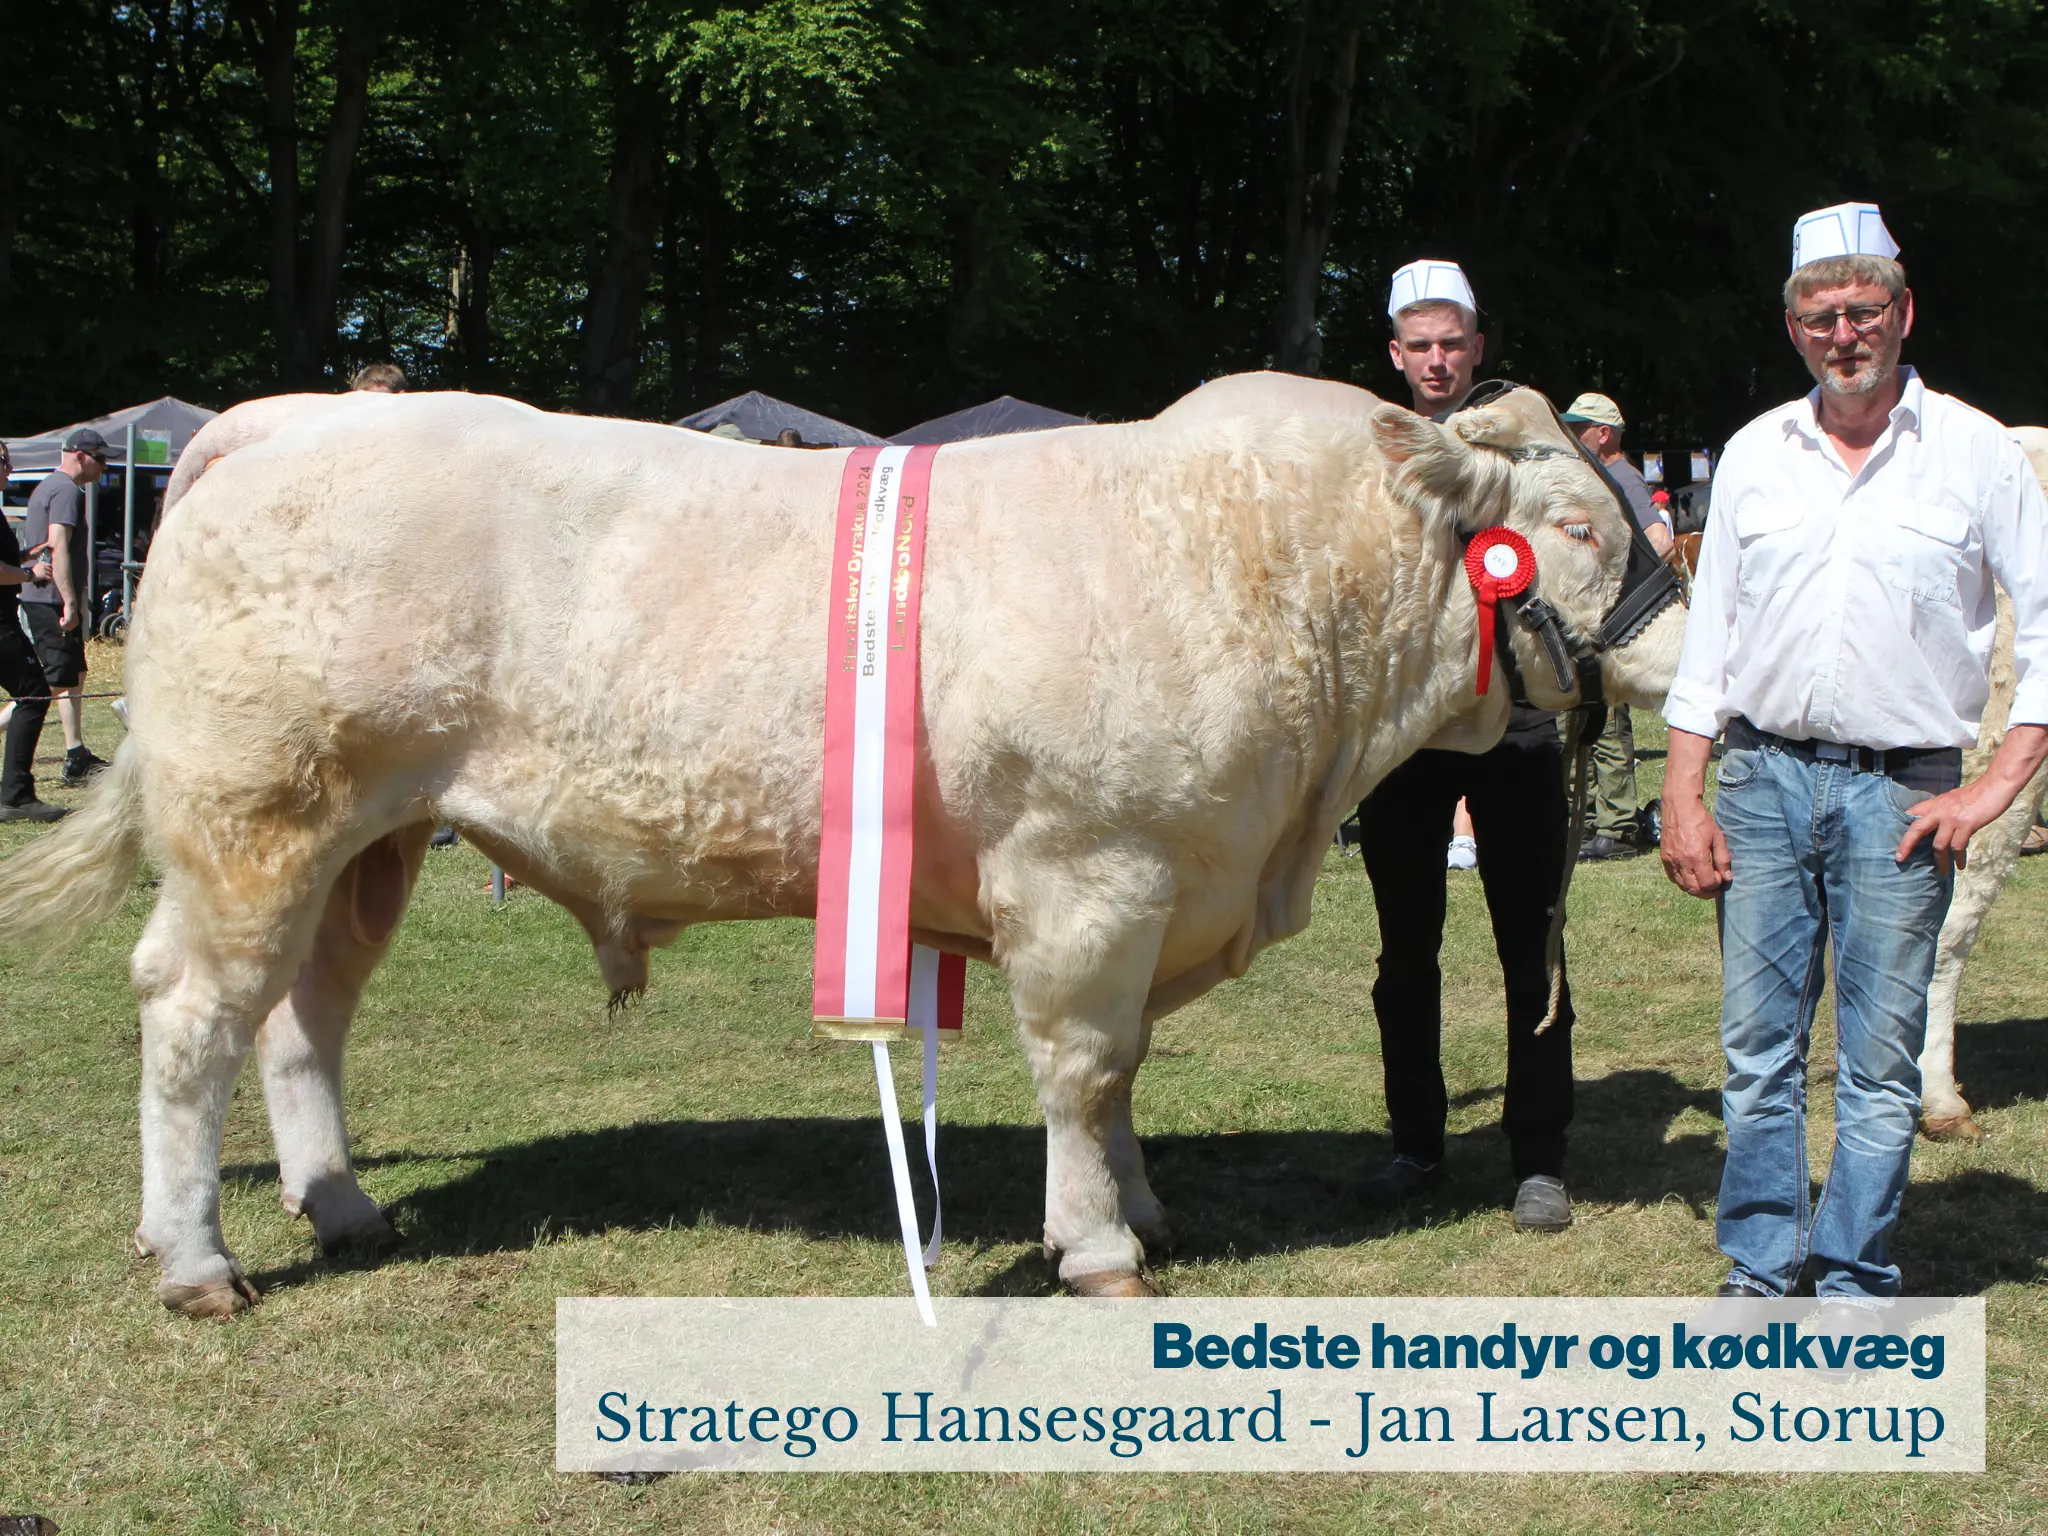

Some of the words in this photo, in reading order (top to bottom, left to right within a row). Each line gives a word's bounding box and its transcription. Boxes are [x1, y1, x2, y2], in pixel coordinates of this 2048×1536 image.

[848, 502, 866, 572] Dyrskue
[857, 466, 871, 498] 2024
[862, 610, 876, 677] Bedste
